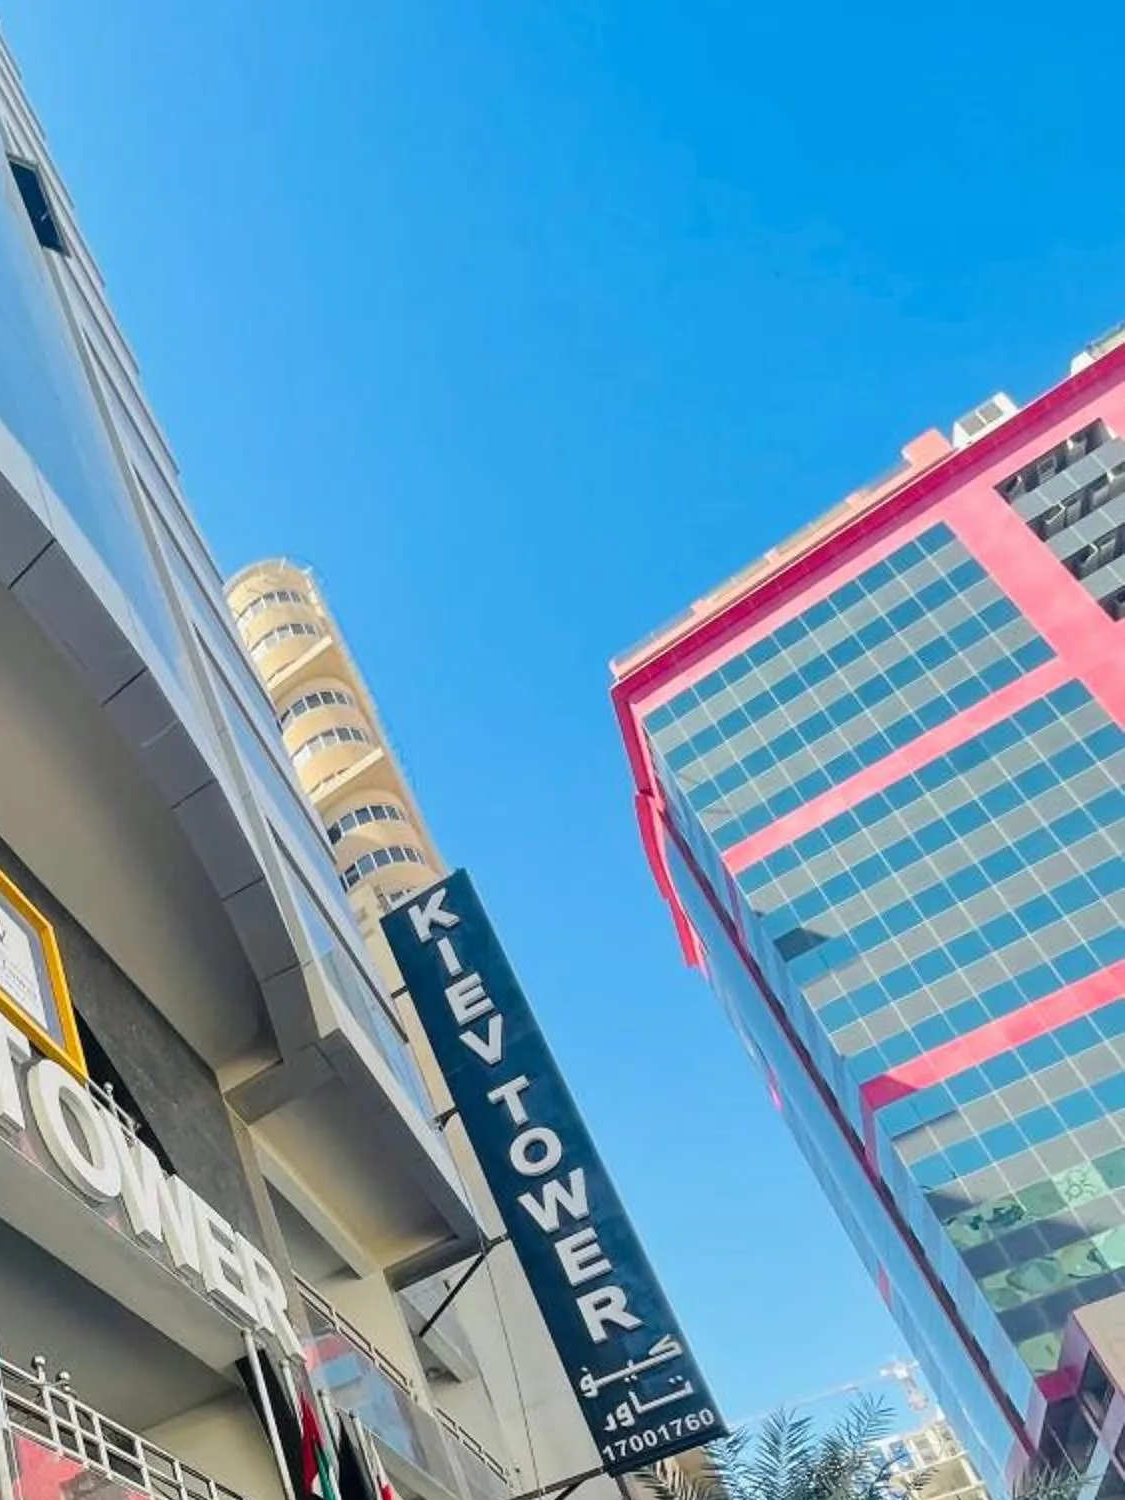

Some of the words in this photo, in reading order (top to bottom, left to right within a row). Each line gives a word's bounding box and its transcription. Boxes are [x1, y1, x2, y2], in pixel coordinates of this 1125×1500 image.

[407, 887, 504, 1065] KIEV
[487, 1074, 643, 1344] TOWER
[602, 1407, 715, 1462] 17001760
